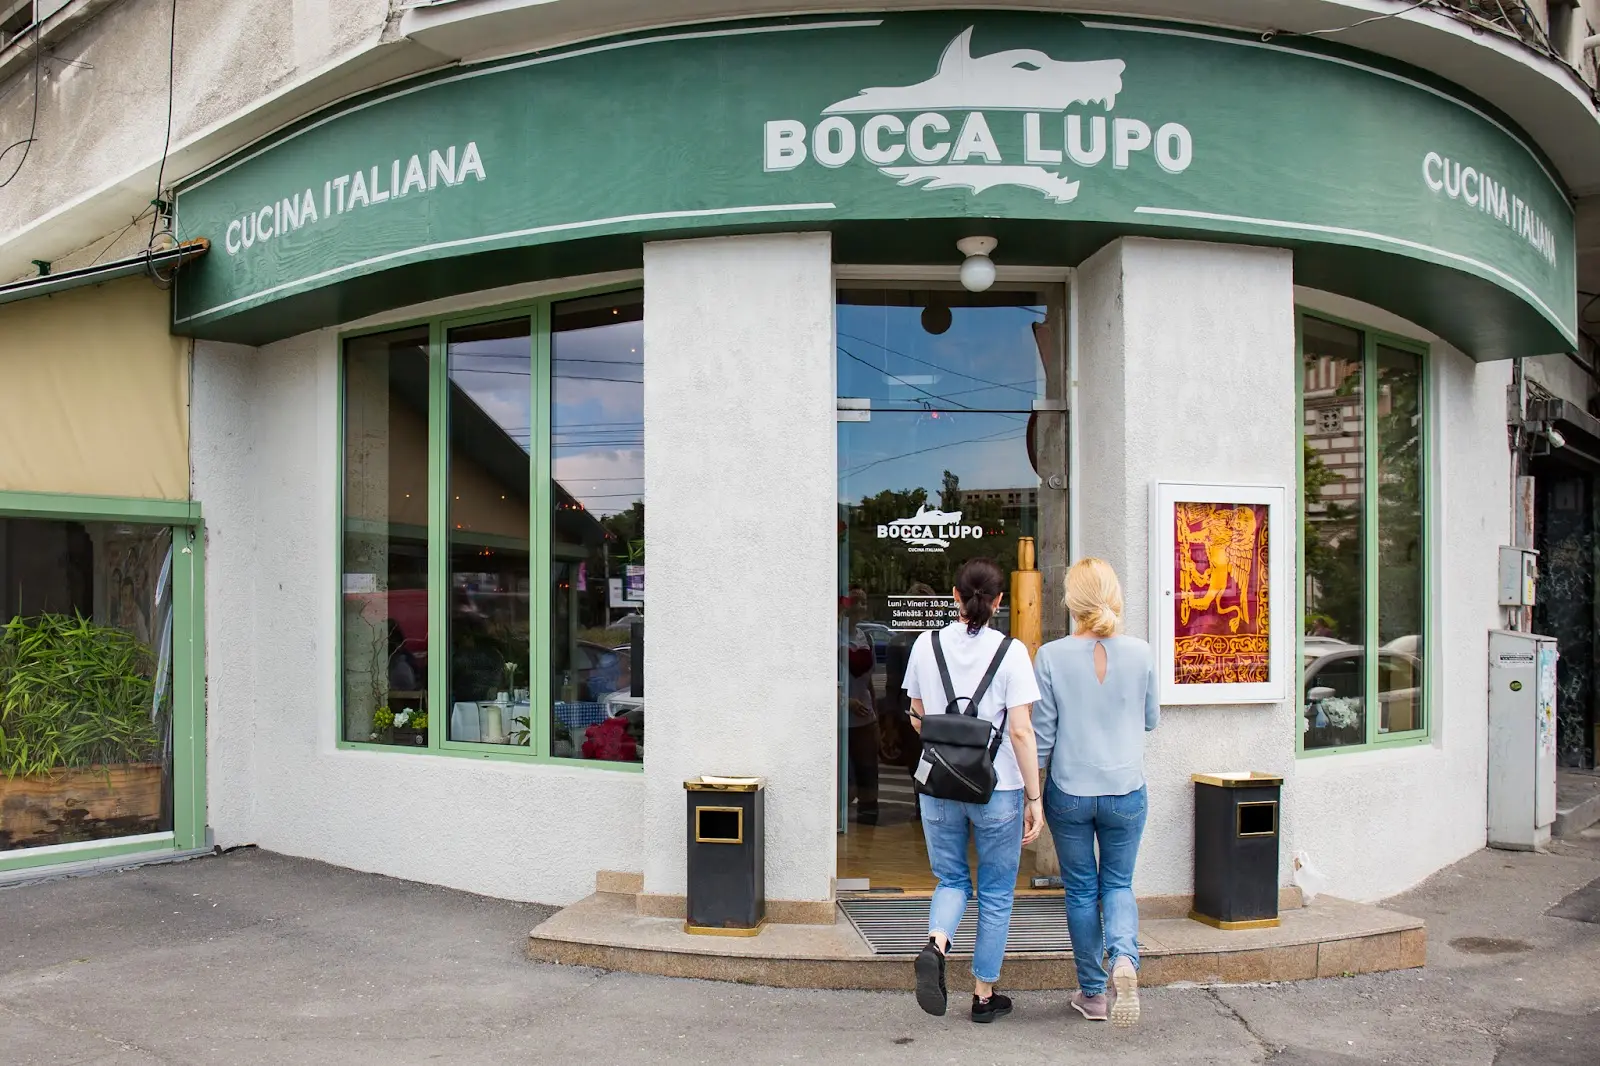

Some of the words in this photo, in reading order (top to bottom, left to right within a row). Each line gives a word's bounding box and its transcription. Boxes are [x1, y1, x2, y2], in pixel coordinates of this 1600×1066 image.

[763, 111, 1002, 173] BOCCA
[1024, 112, 1193, 174] LUPO
[225, 188, 318, 256] CUCINA
[323, 141, 487, 219] ITALIANA
[1422, 151, 1510, 226] CUCINA
[1511, 193, 1557, 268] ITALIANA
[877, 524, 934, 538] BOCCA
[938, 525, 983, 538] LUPO
